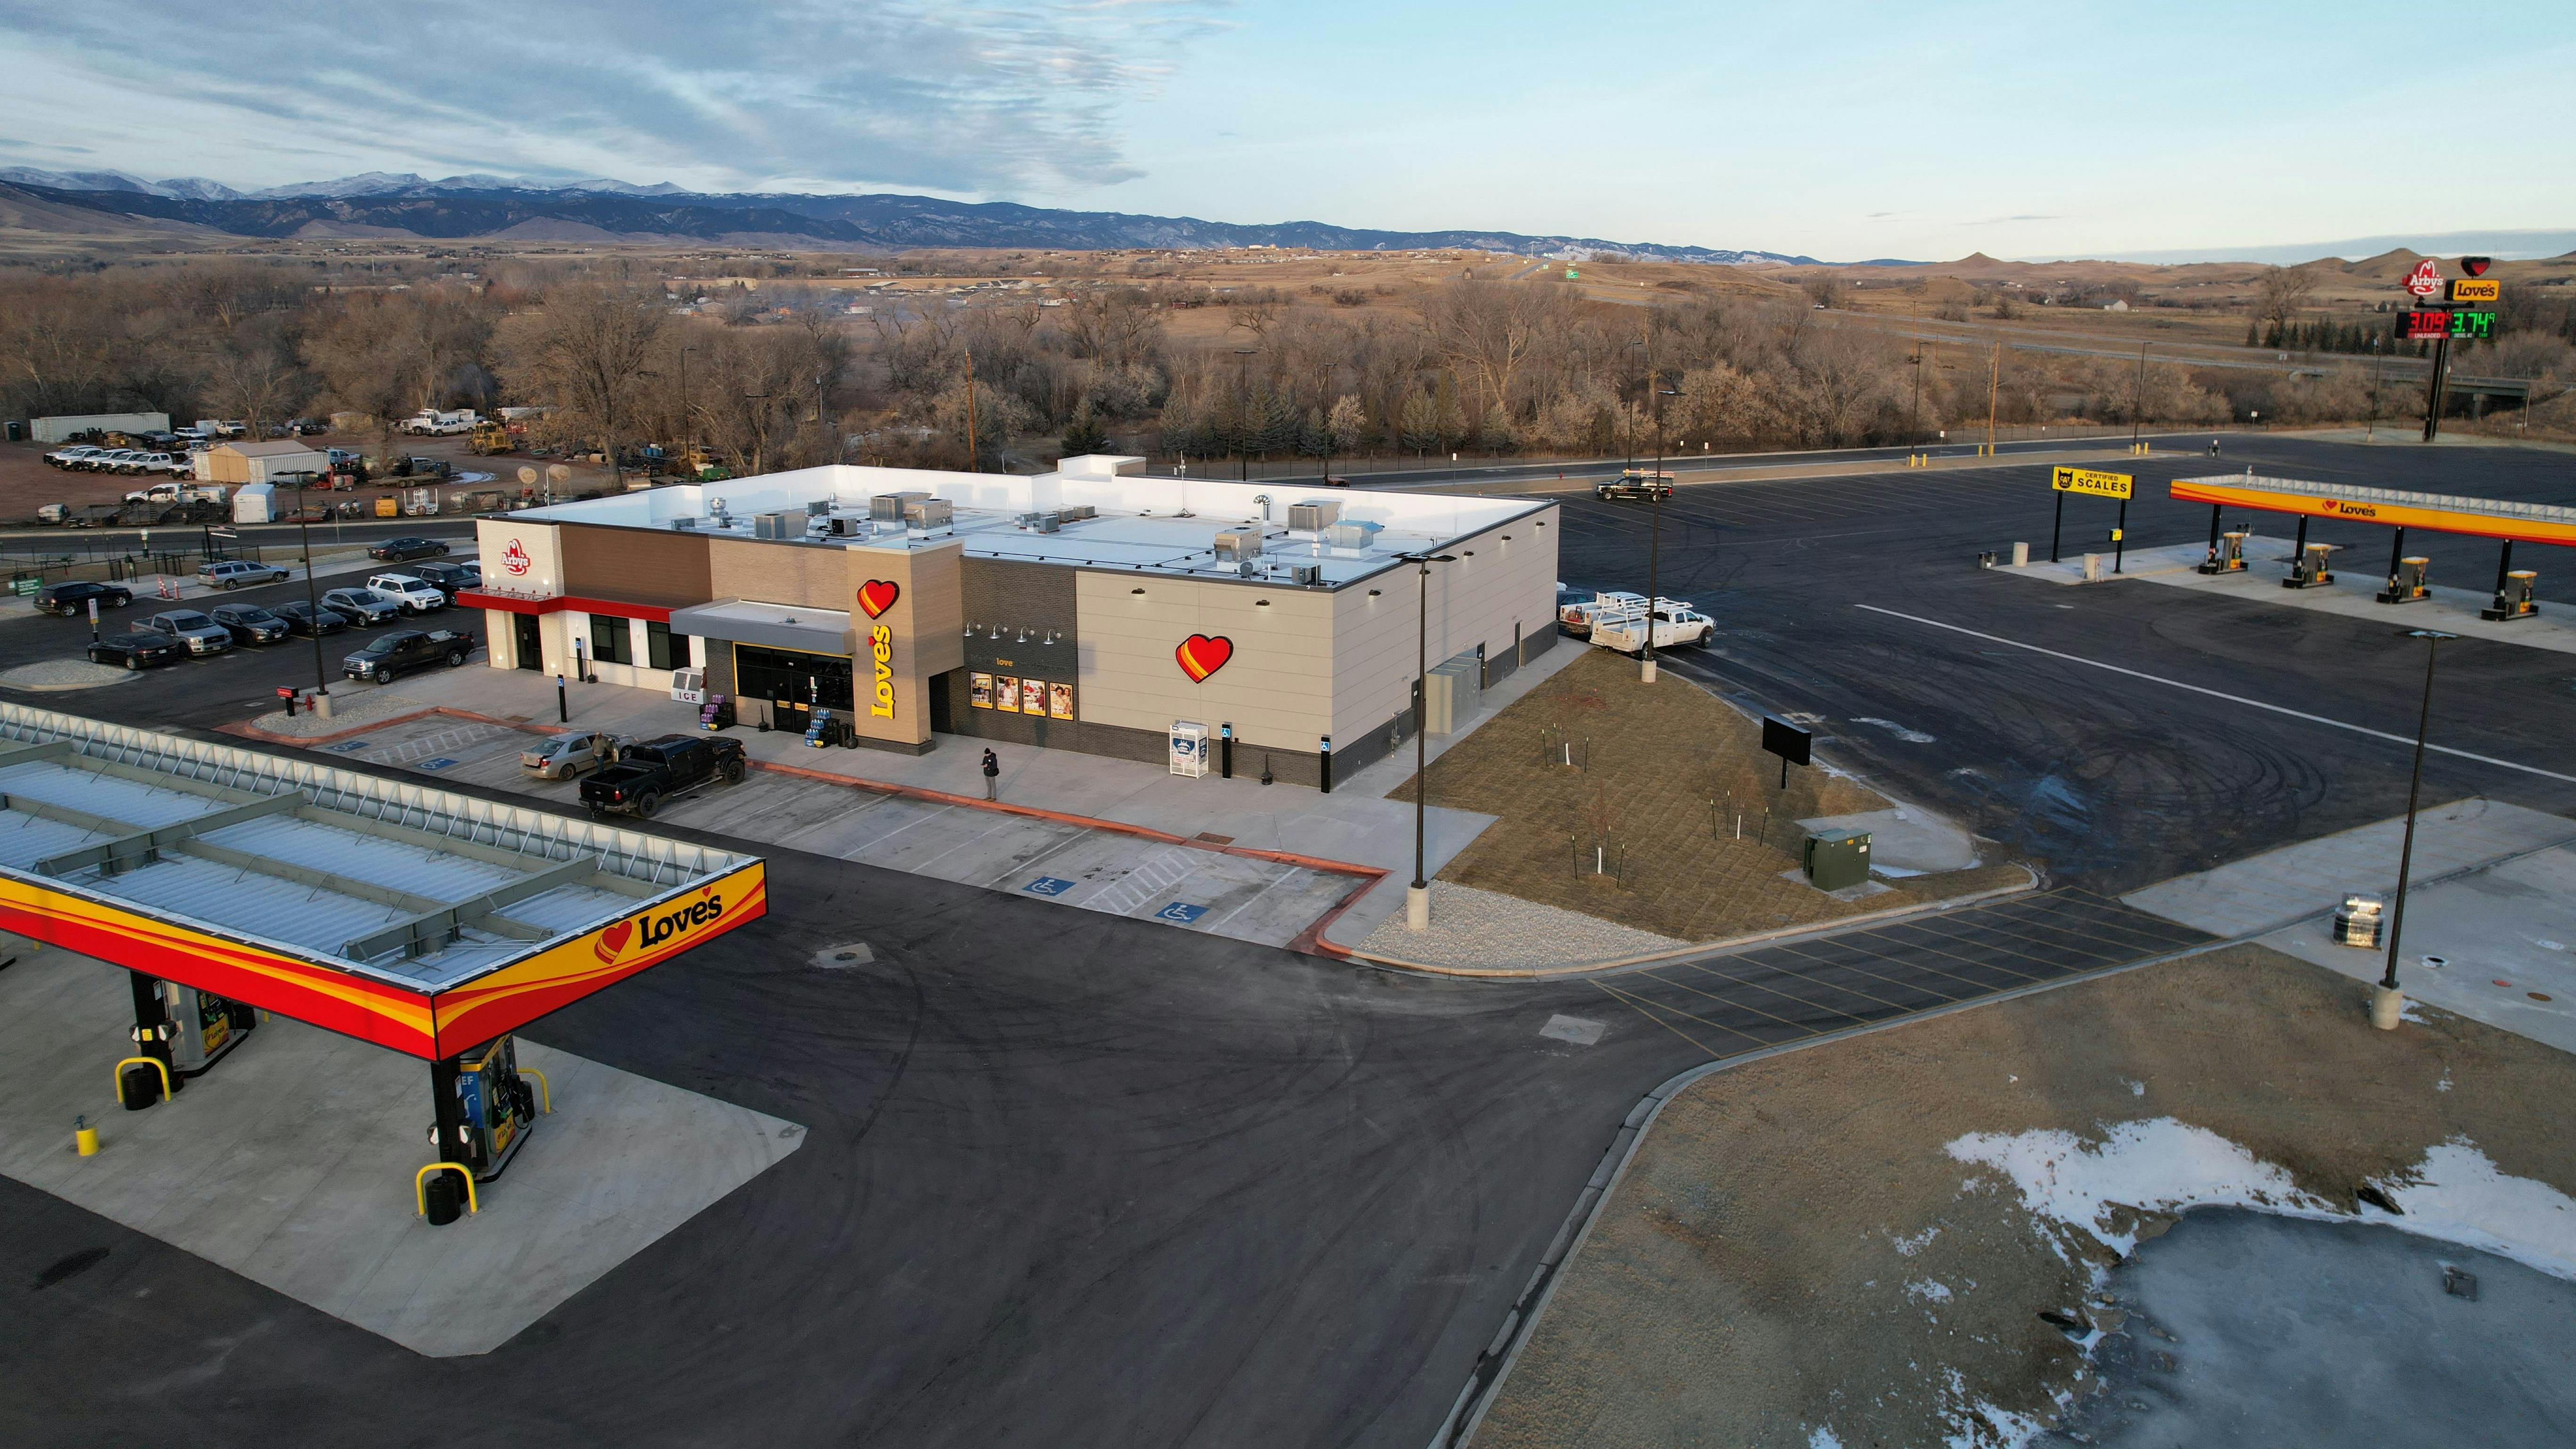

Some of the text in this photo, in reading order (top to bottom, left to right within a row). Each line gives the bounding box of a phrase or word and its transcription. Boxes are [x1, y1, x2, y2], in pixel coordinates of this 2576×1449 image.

[2410, 274, 2443, 289] Arby's
[2456, 283, 2495, 297] Love's
[2452, 313, 2488, 332] 3.74
[2060, 475, 2070, 483] CAT
[2085, 472, 2118, 481] CERTIFIED
[2077, 478, 2127, 492] SCALES
[2339, 503, 2376, 517] Love's
[501, 553, 528, 569] Arby's
[996, 657, 1014, 667] love
[868, 625, 894, 720] Love's
[679, 692, 697, 701] ICE
[639, 886, 722, 949] Love's
[461, 1076, 474, 1086] EF
